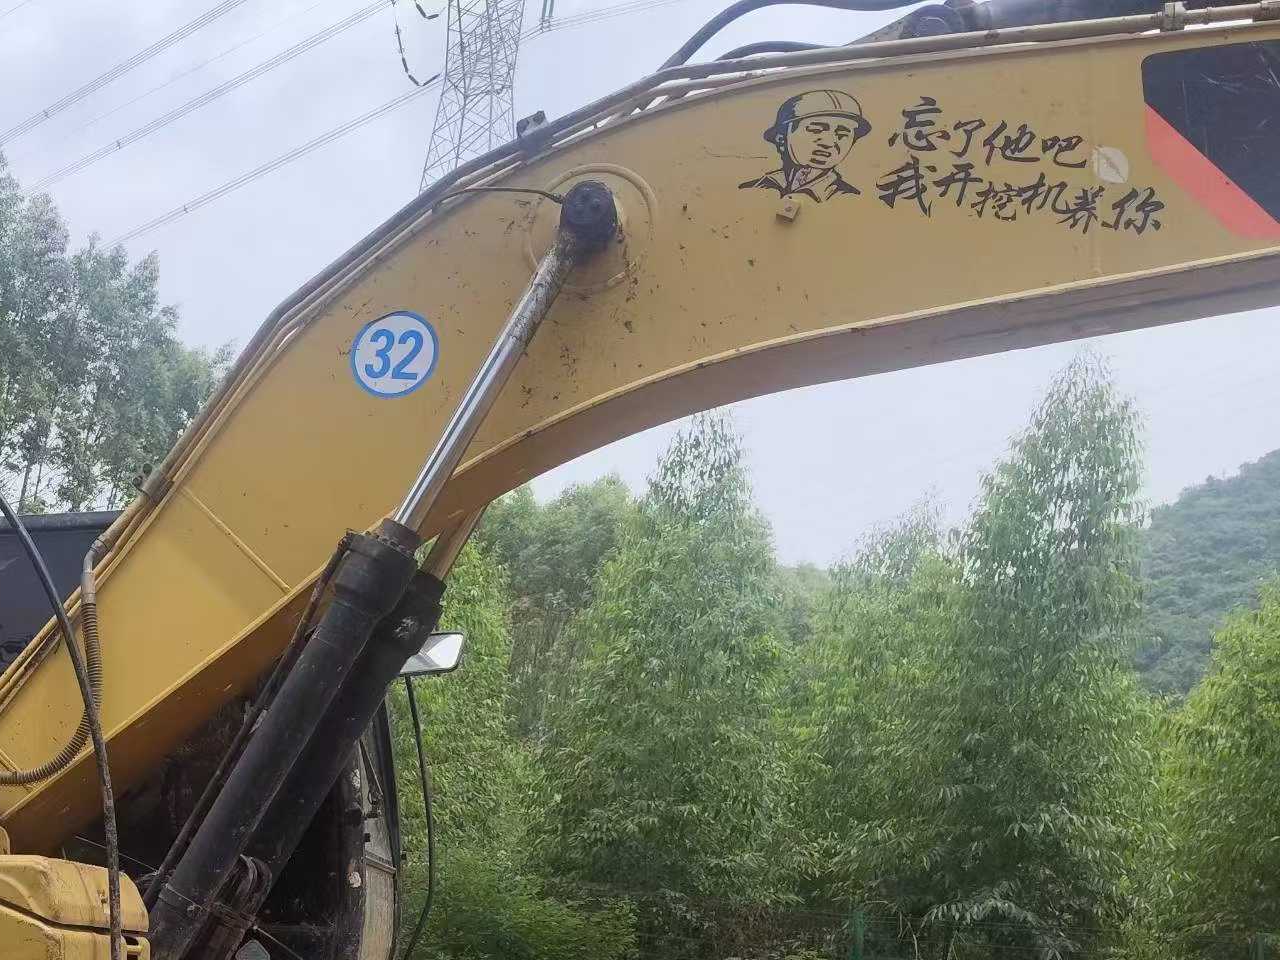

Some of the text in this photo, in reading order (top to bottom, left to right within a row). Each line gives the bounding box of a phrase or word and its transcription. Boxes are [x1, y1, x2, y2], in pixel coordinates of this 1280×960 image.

[888, 96, 1087, 168] 忘了他吧
[875, 154, 1165, 235] 我开挖机养你
[364, 328, 424, 380] 32
